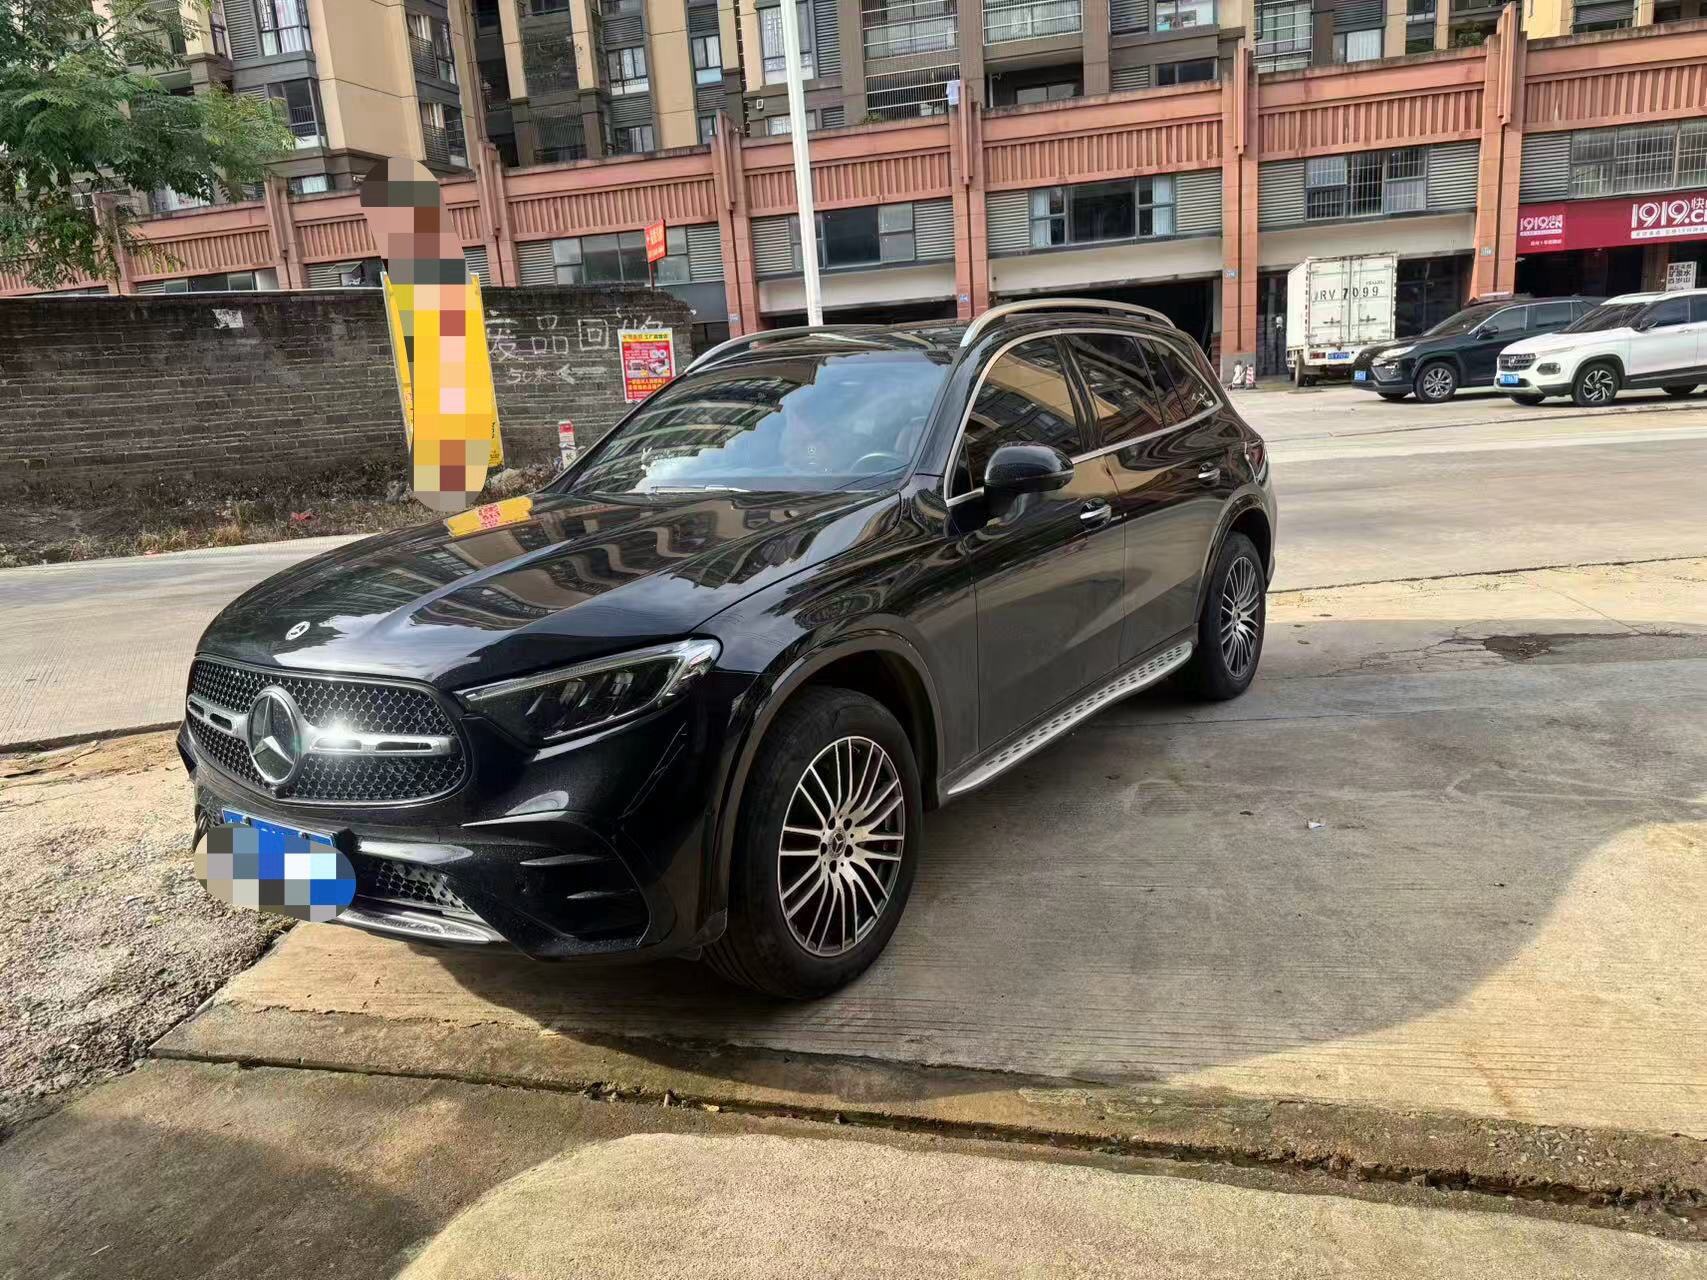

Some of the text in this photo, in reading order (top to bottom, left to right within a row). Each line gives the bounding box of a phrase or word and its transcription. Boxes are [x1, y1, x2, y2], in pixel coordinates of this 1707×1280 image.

[1691, 197, 1707, 210] 快
[1520, 216, 1563, 231] 1919.CN
[1343, 286, 1379, 300] 7099
